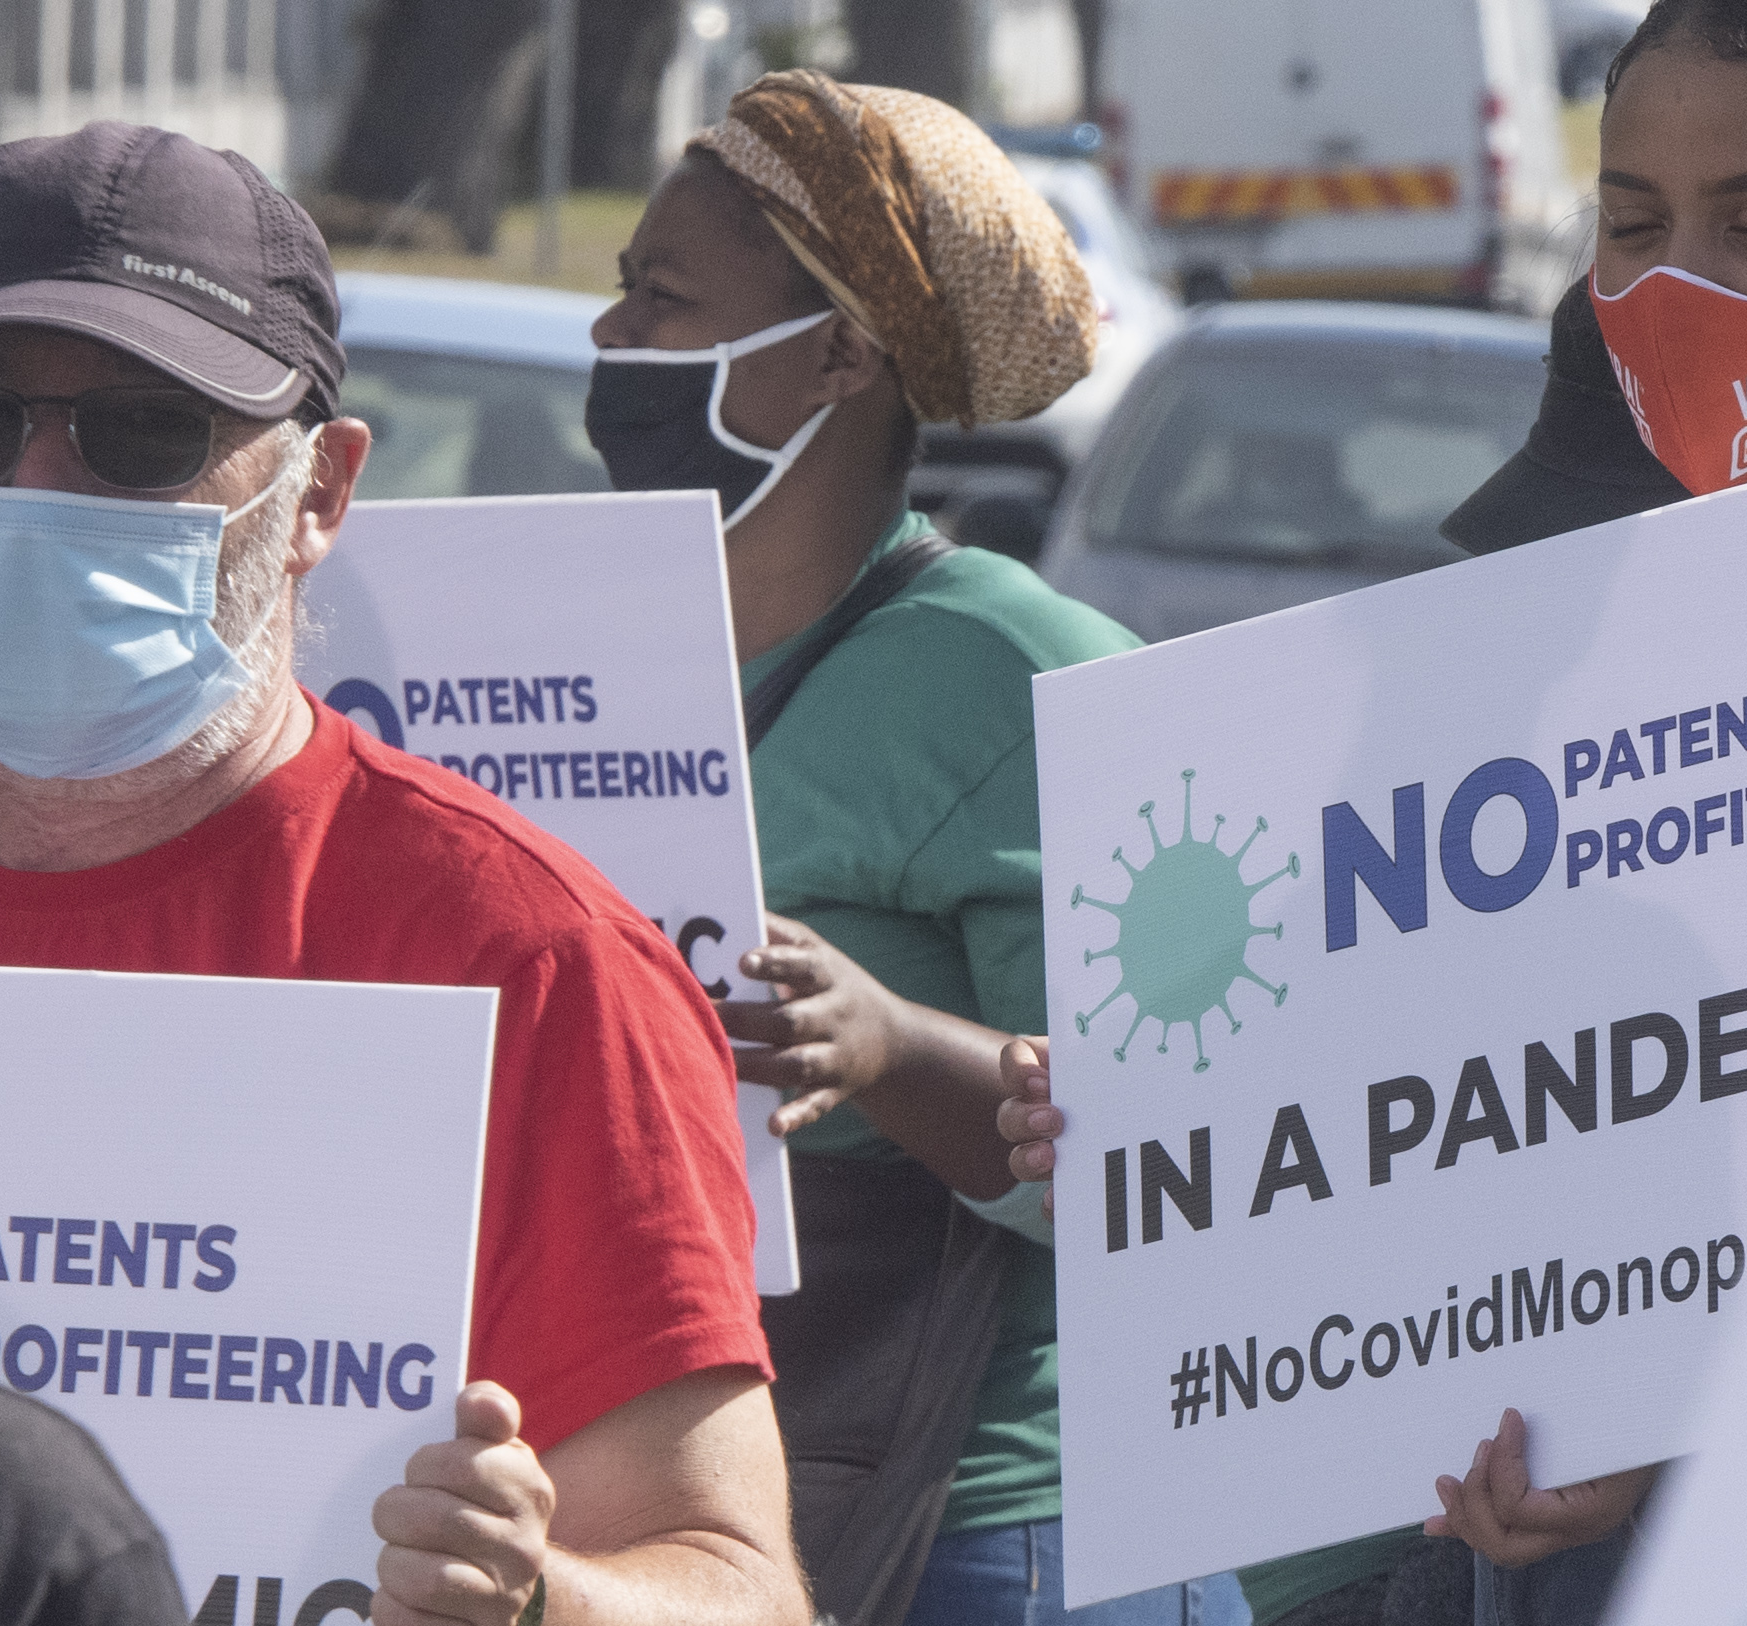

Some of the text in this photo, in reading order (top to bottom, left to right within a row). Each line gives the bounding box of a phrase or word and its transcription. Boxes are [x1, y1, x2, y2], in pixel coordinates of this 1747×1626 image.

[122, 253, 252, 317] first Ascent
[402, 675, 598, 725] PATENTS
[1322, 757, 1559, 953] NO
[1104, 1126, 1213, 1254] IN
[1249, 1102, 1333, 1218] A
